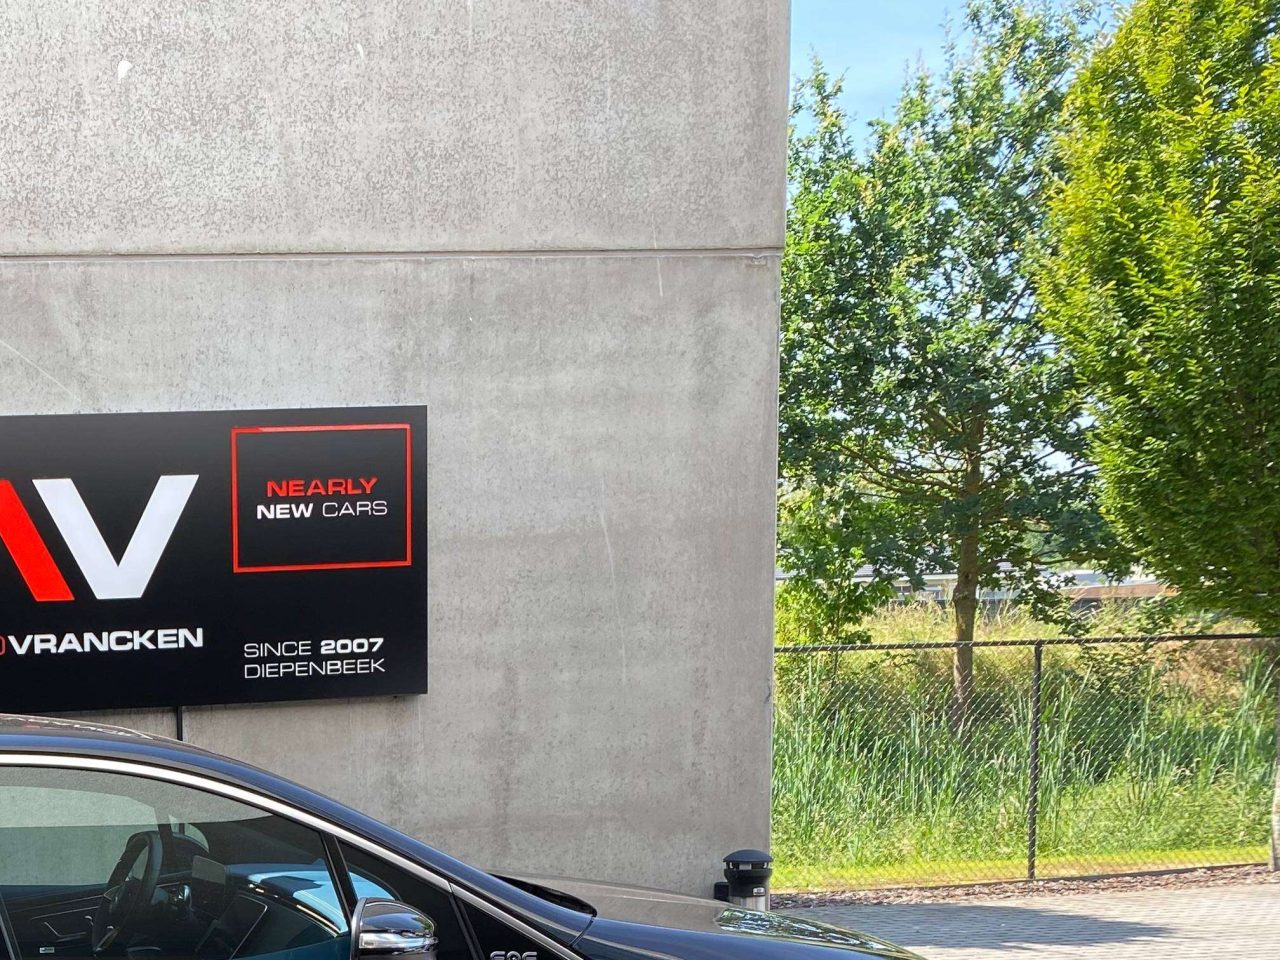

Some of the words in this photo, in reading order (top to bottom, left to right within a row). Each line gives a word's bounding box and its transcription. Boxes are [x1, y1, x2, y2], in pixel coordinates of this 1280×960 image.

[266, 477, 378, 497] NEARLY
[257, 503, 314, 520] NEW
[323, 501, 388, 518] CARS
[244, 641, 312, 658] SINCE
[321, 637, 384, 655] 2007
[244, 657, 386, 679] DIEPENBEEK
